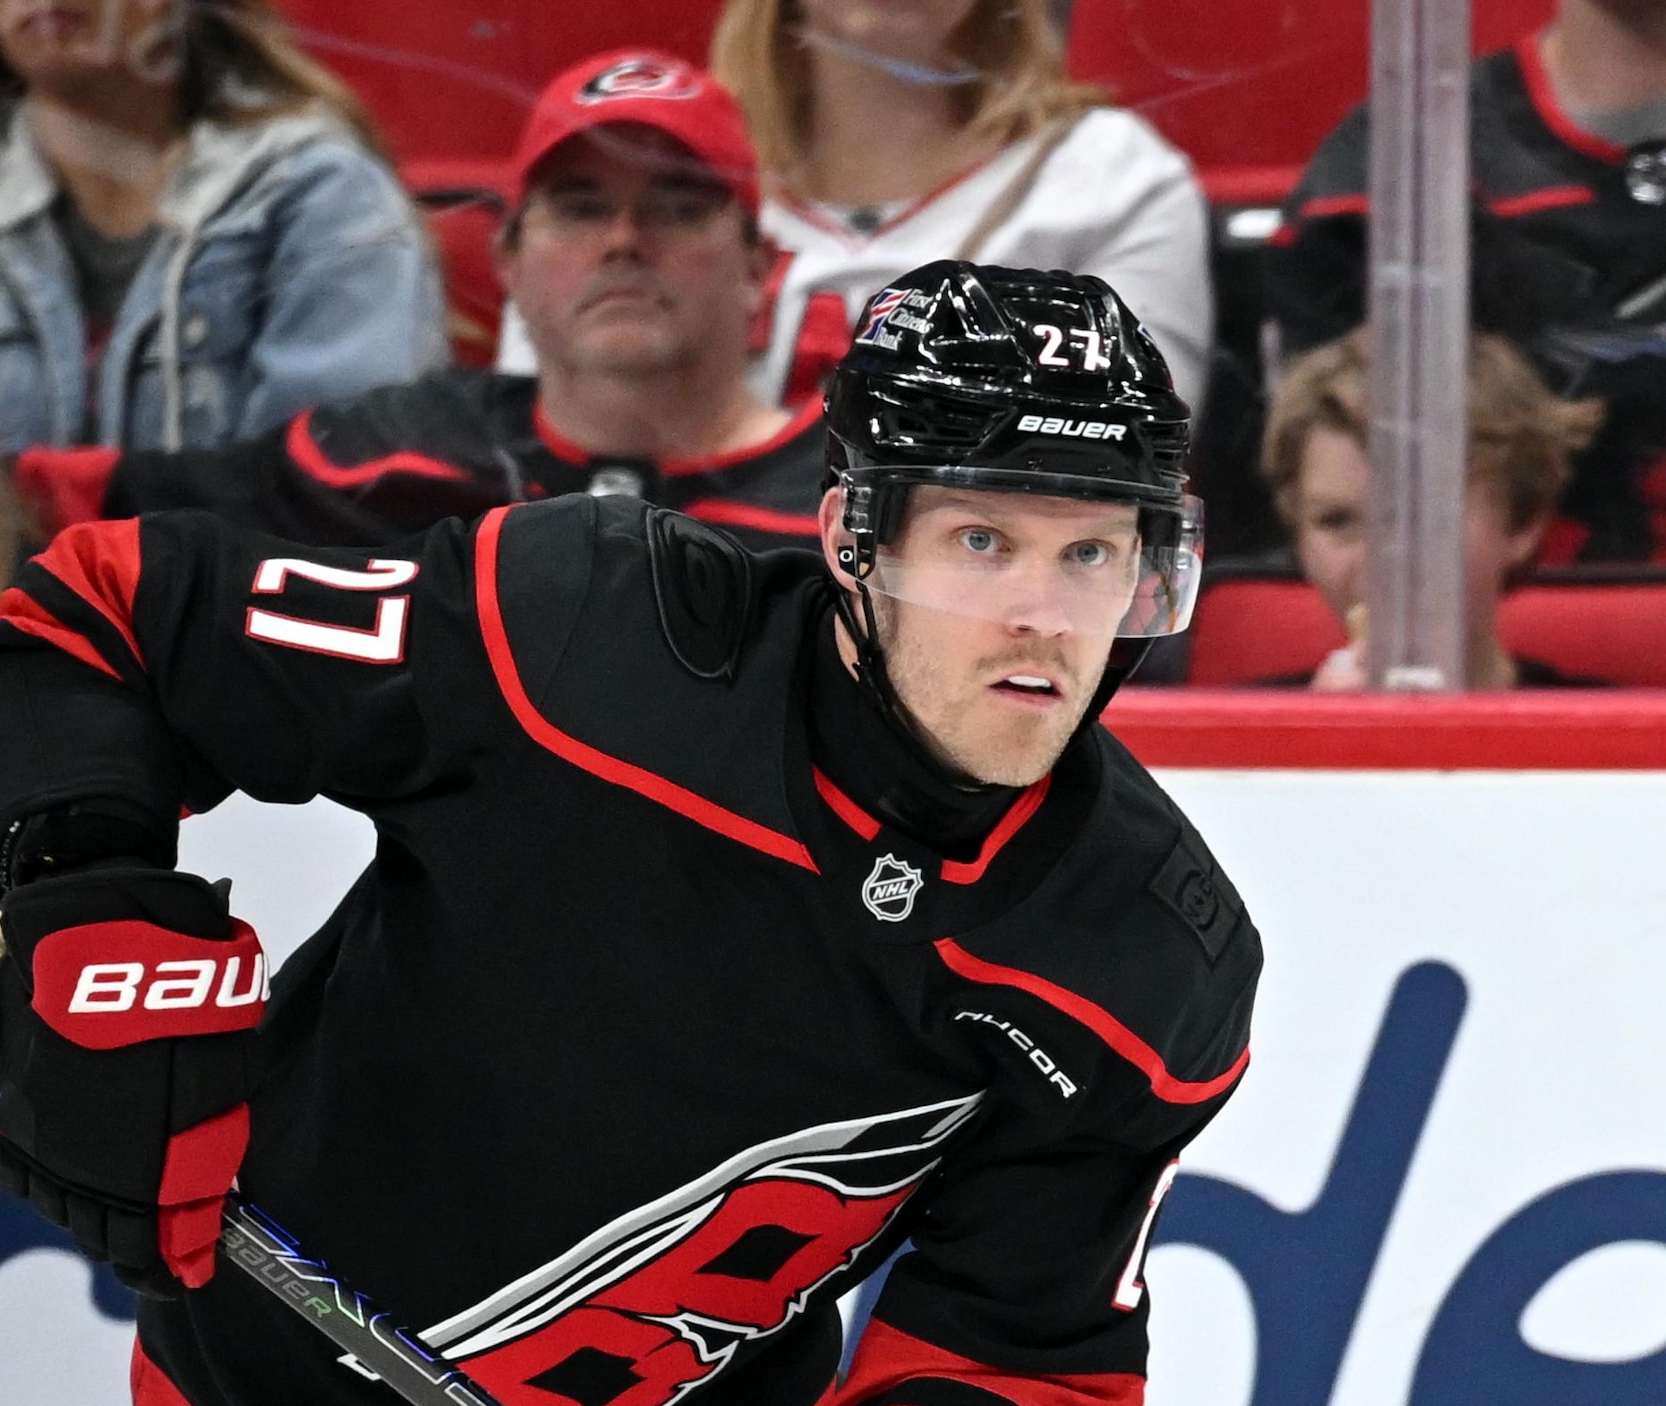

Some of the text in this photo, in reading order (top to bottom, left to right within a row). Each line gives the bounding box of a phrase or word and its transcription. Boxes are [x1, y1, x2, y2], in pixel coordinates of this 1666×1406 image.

[1033, 324, 1110, 371] 27
[244, 556, 419, 666] 27
[873, 881, 909, 900] NHL
